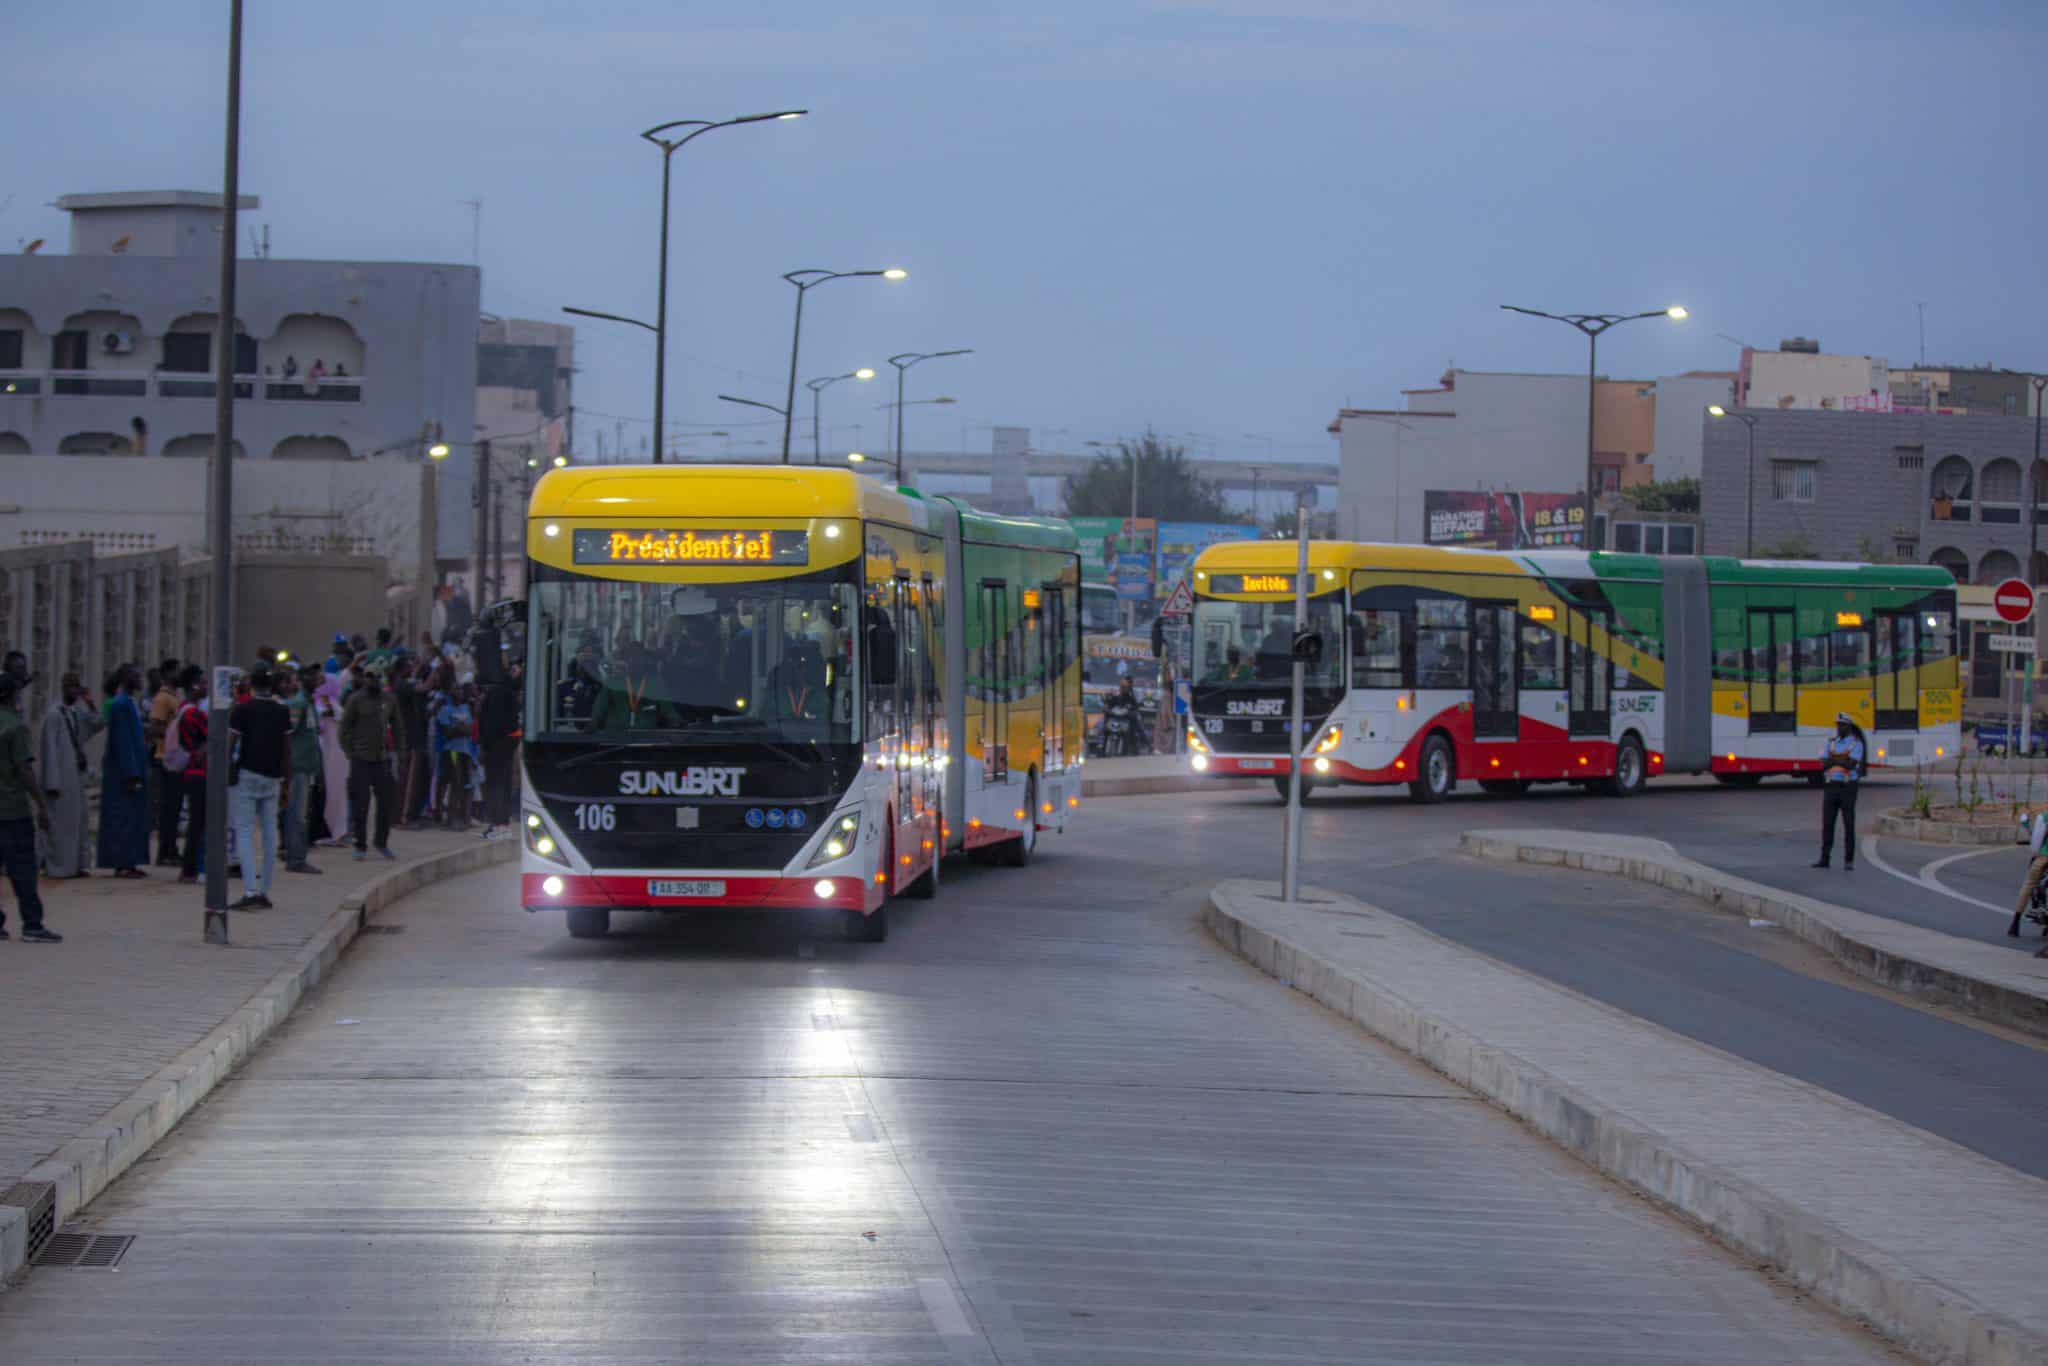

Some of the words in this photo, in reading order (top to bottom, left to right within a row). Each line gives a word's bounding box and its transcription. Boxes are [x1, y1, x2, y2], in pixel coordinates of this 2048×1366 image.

[1535, 511, 1551, 526] 18
[1553, 508, 1565, 524] &
[1568, 507, 1585, 523] 19
[610, 532, 772, 559] Présidentiel
[575, 804, 616, 831] 106
